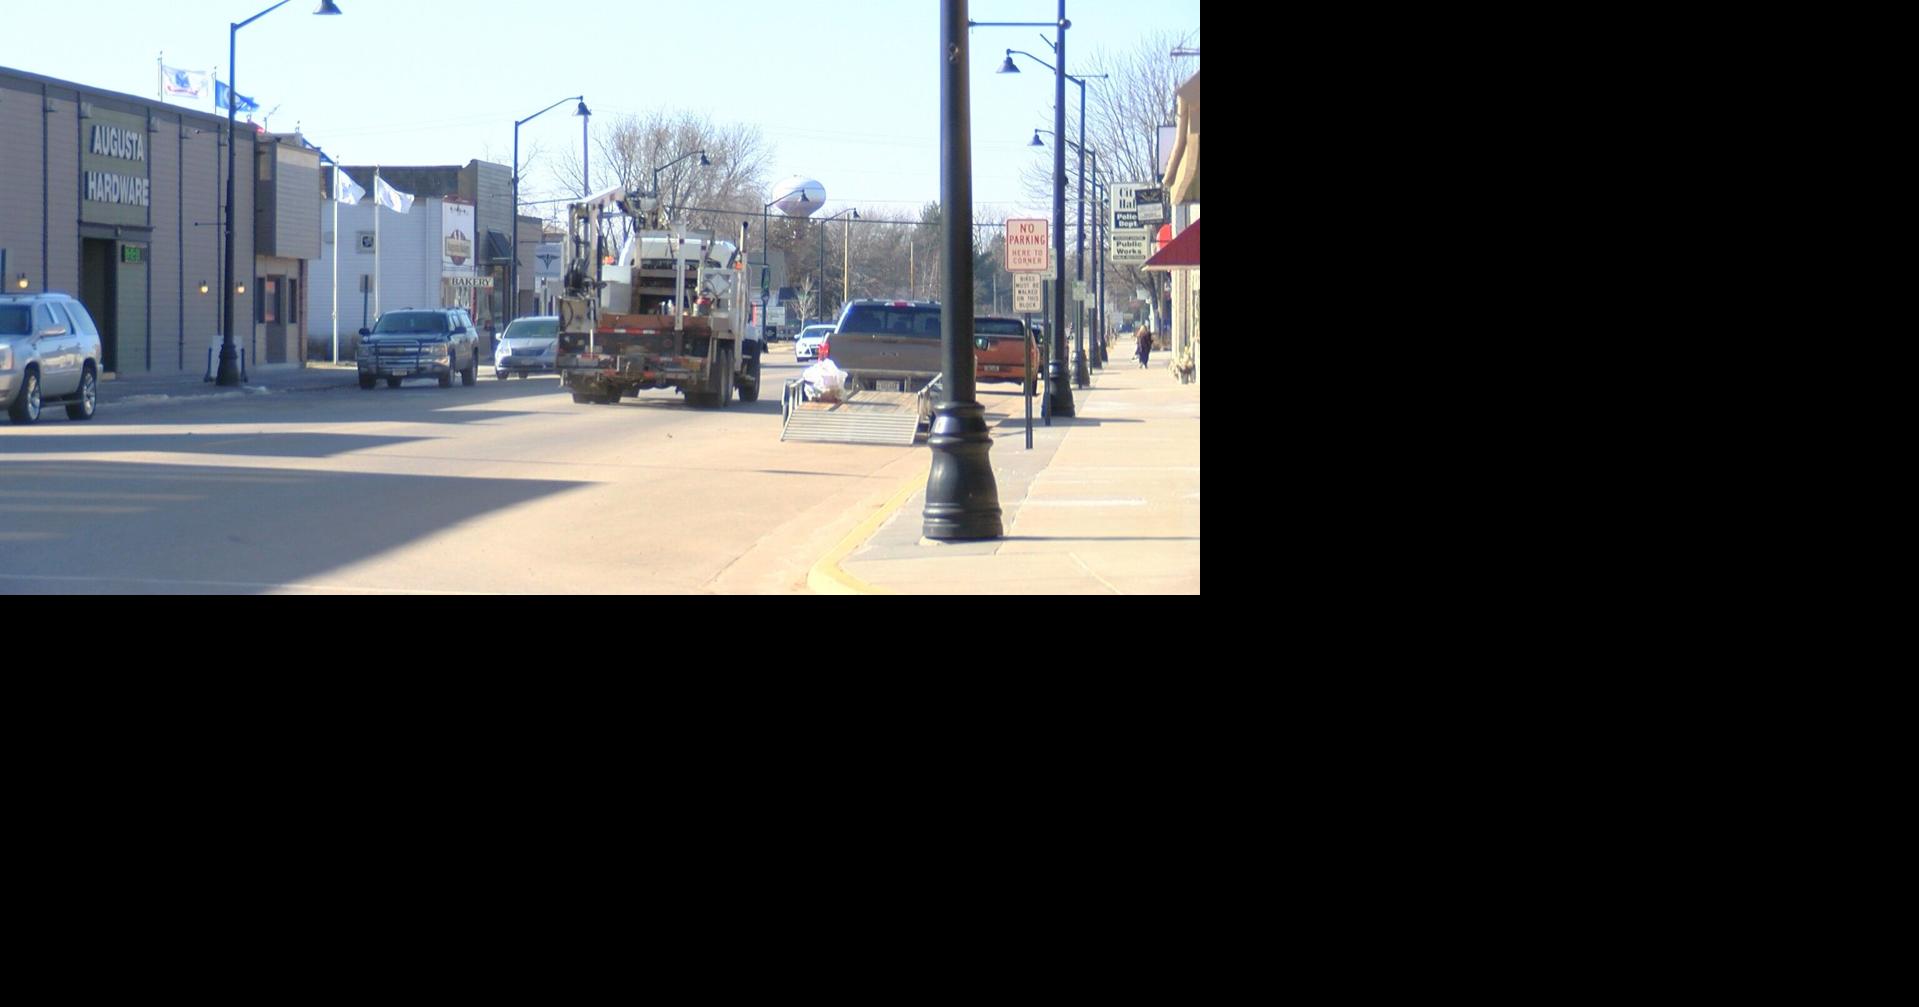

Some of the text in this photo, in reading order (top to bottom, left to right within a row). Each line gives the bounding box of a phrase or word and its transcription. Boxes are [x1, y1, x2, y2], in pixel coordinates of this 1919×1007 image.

[92, 125, 144, 161] AUGUSTA
[87, 170, 149, 207] HARDWARE
[1119, 199, 1136, 209] Hal
[1116, 213, 1137, 221] Polic
[1020, 223, 1034, 233] NO
[1009, 235, 1045, 245] PARKING
[452, 277, 490, 286] BAKERY
